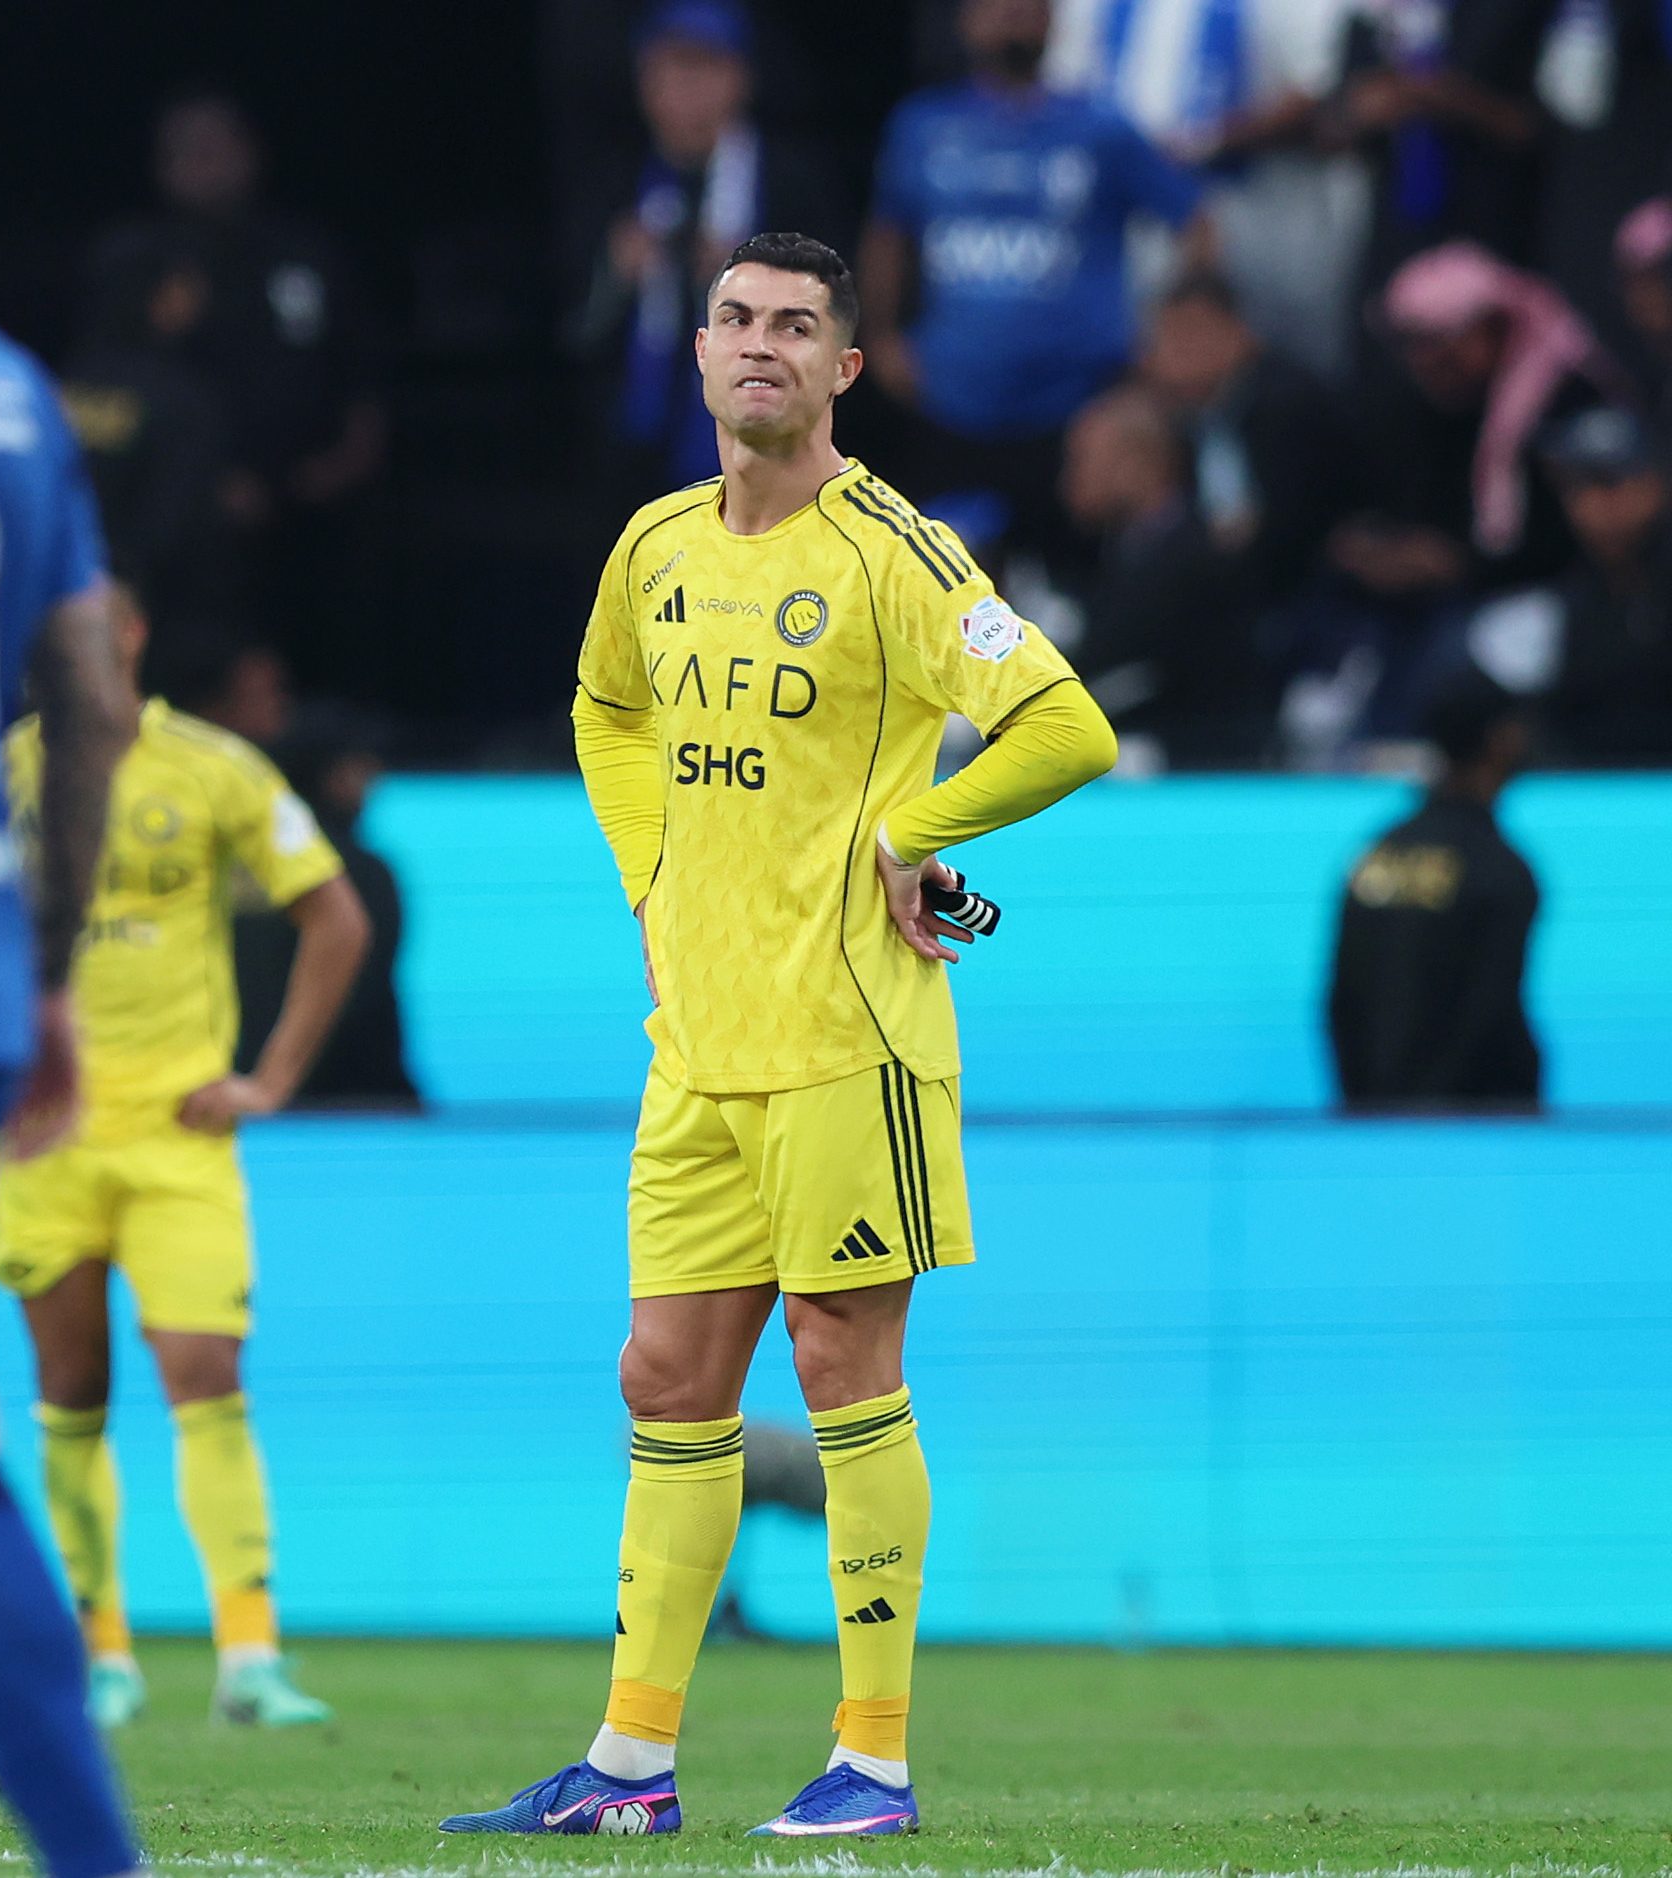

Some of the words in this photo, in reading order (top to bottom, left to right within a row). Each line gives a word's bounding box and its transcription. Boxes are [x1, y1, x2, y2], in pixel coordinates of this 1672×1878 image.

[982, 622, 1005, 640] RSL
[649, 651, 817, 719] KAFD
[668, 742, 765, 791] SHG
[838, 1545, 902, 1573] 1955
